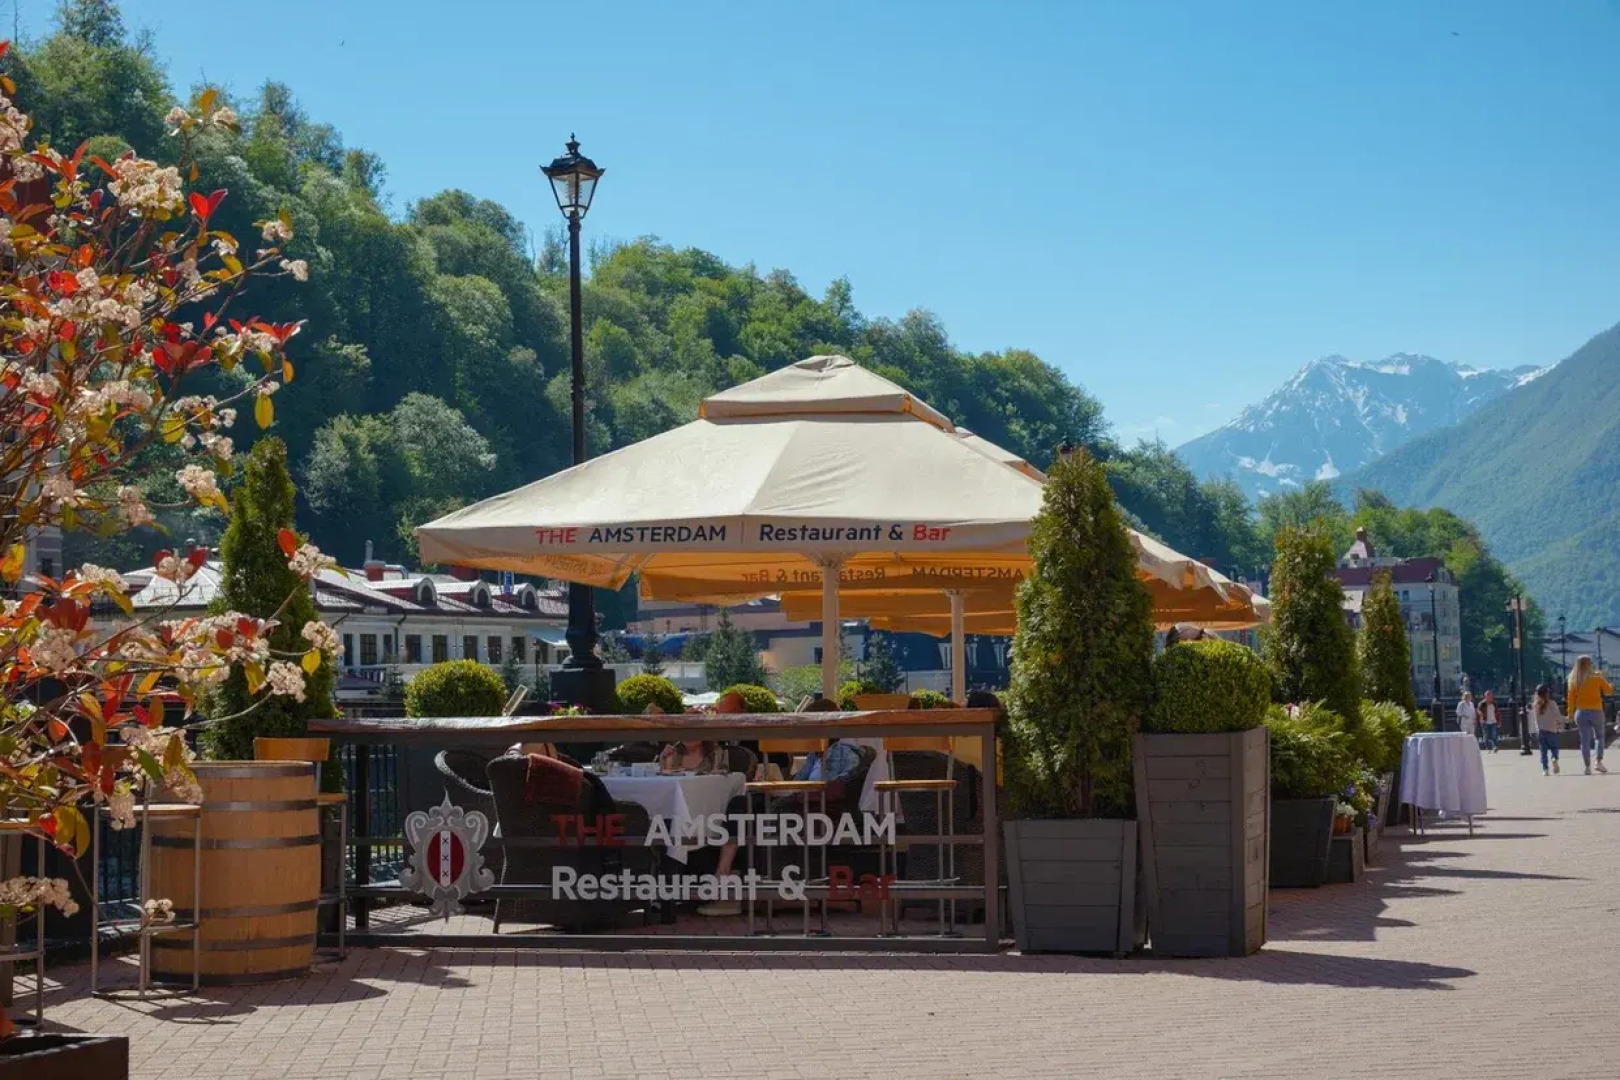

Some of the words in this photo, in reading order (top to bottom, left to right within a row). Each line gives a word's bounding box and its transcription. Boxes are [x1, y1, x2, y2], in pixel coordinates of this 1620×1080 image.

[536, 529, 577, 544] THE
[588, 525, 726, 543] AMSTERDAM
[759, 524, 882, 542] Restaurant
[888, 525, 903, 541] &
[913, 524, 950, 542] Bar
[552, 814, 627, 846] THE
[643, 813, 896, 847] AMSTERDAM
[552, 865, 761, 900] Restaurant
[779, 864, 809, 900] &
[828, 865, 897, 900] Bar
